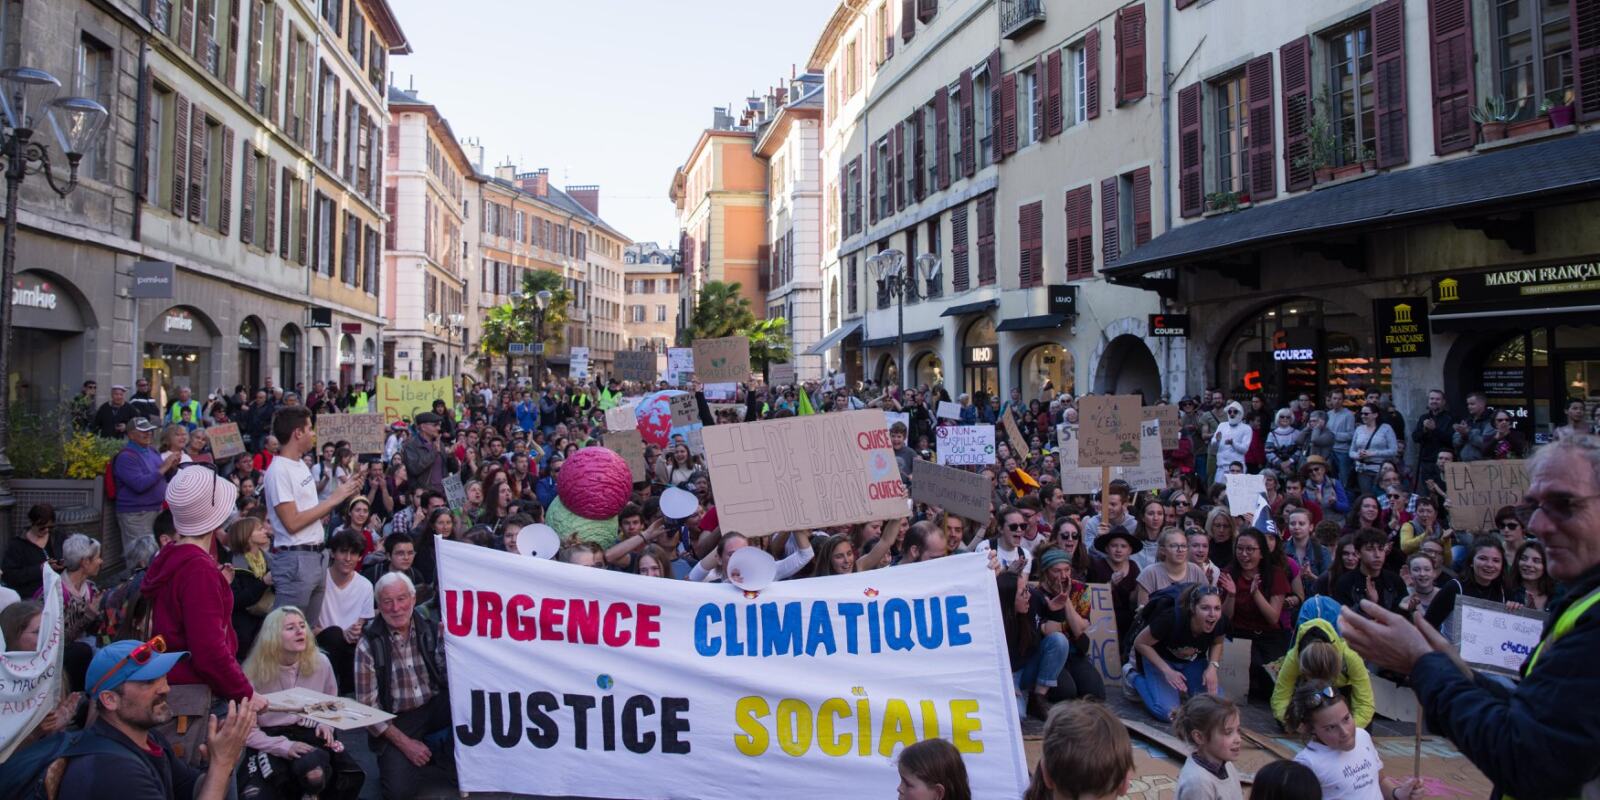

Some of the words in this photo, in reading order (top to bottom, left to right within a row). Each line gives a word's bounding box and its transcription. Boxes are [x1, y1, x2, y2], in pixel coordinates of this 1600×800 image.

[137, 275, 169, 286] pimkie
[1485, 268, 1537, 286] MAISON
[1154, 327, 1184, 335] COURIR
[1390, 325, 1418, 334] MAISON
[1385, 334, 1425, 344] FRANÇAISE
[1273, 349, 1314, 361] COURIR
[385, 381, 446, 402] Liberté
[1516, 407, 1529, 418] de
[952, 427, 971, 437] NON
[1115, 432, 1141, 441] NOTRE
[858, 429, 892, 451] QUISE
[943, 435, 986, 446] GASPILLAGE
[1451, 466, 1476, 491] LA
[1488, 463, 1531, 491] PLAN
[1458, 490, 1491, 506] N'EST
[445, 589, 662, 649] URGENCE
[694, 592, 973, 658] CLIMATIQUE
[455, 674, 691, 755] JUSTICE
[733, 687, 986, 758] SOCIALE
